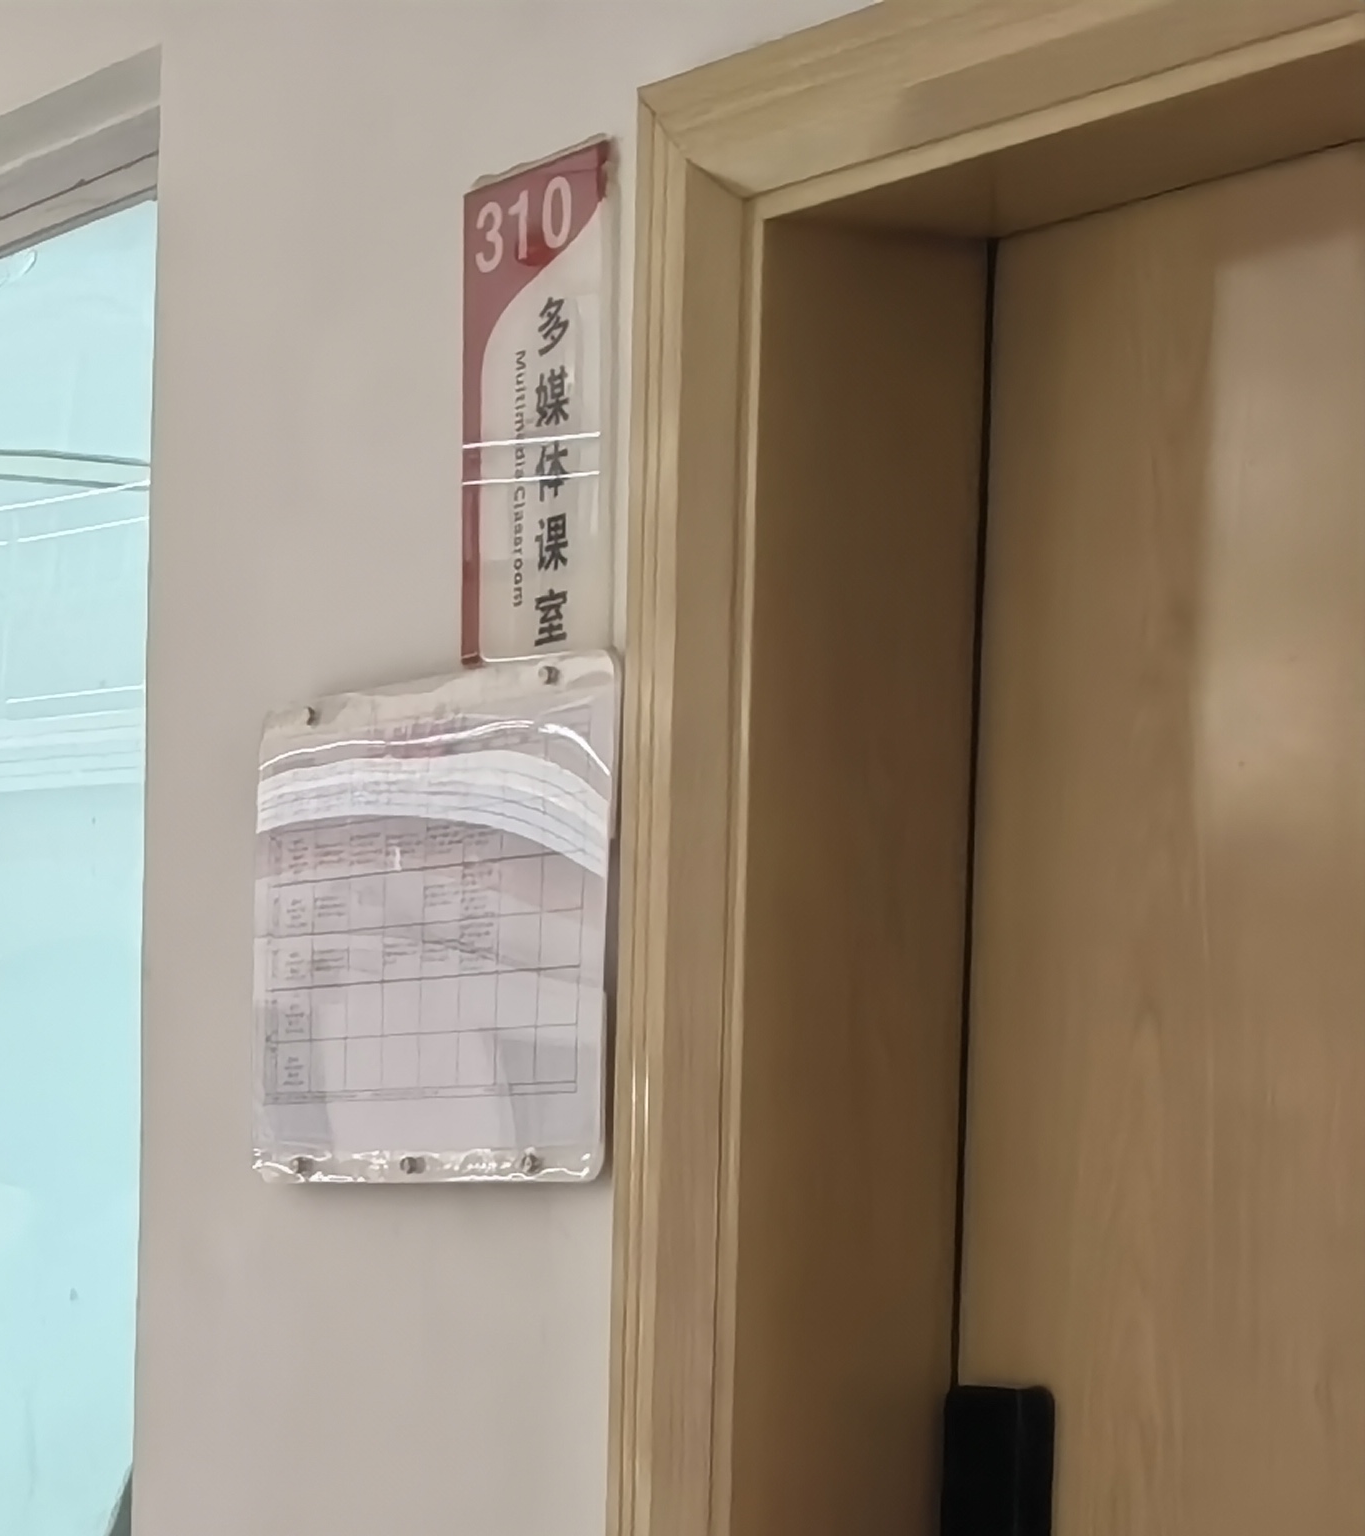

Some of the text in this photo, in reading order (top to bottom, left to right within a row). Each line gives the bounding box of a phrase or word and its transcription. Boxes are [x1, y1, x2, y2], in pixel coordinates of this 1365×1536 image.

[475, 175, 572, 273] 310
[534, 296, 570, 647] 多媒体课室
[512, 485, 526, 608] Classroom
